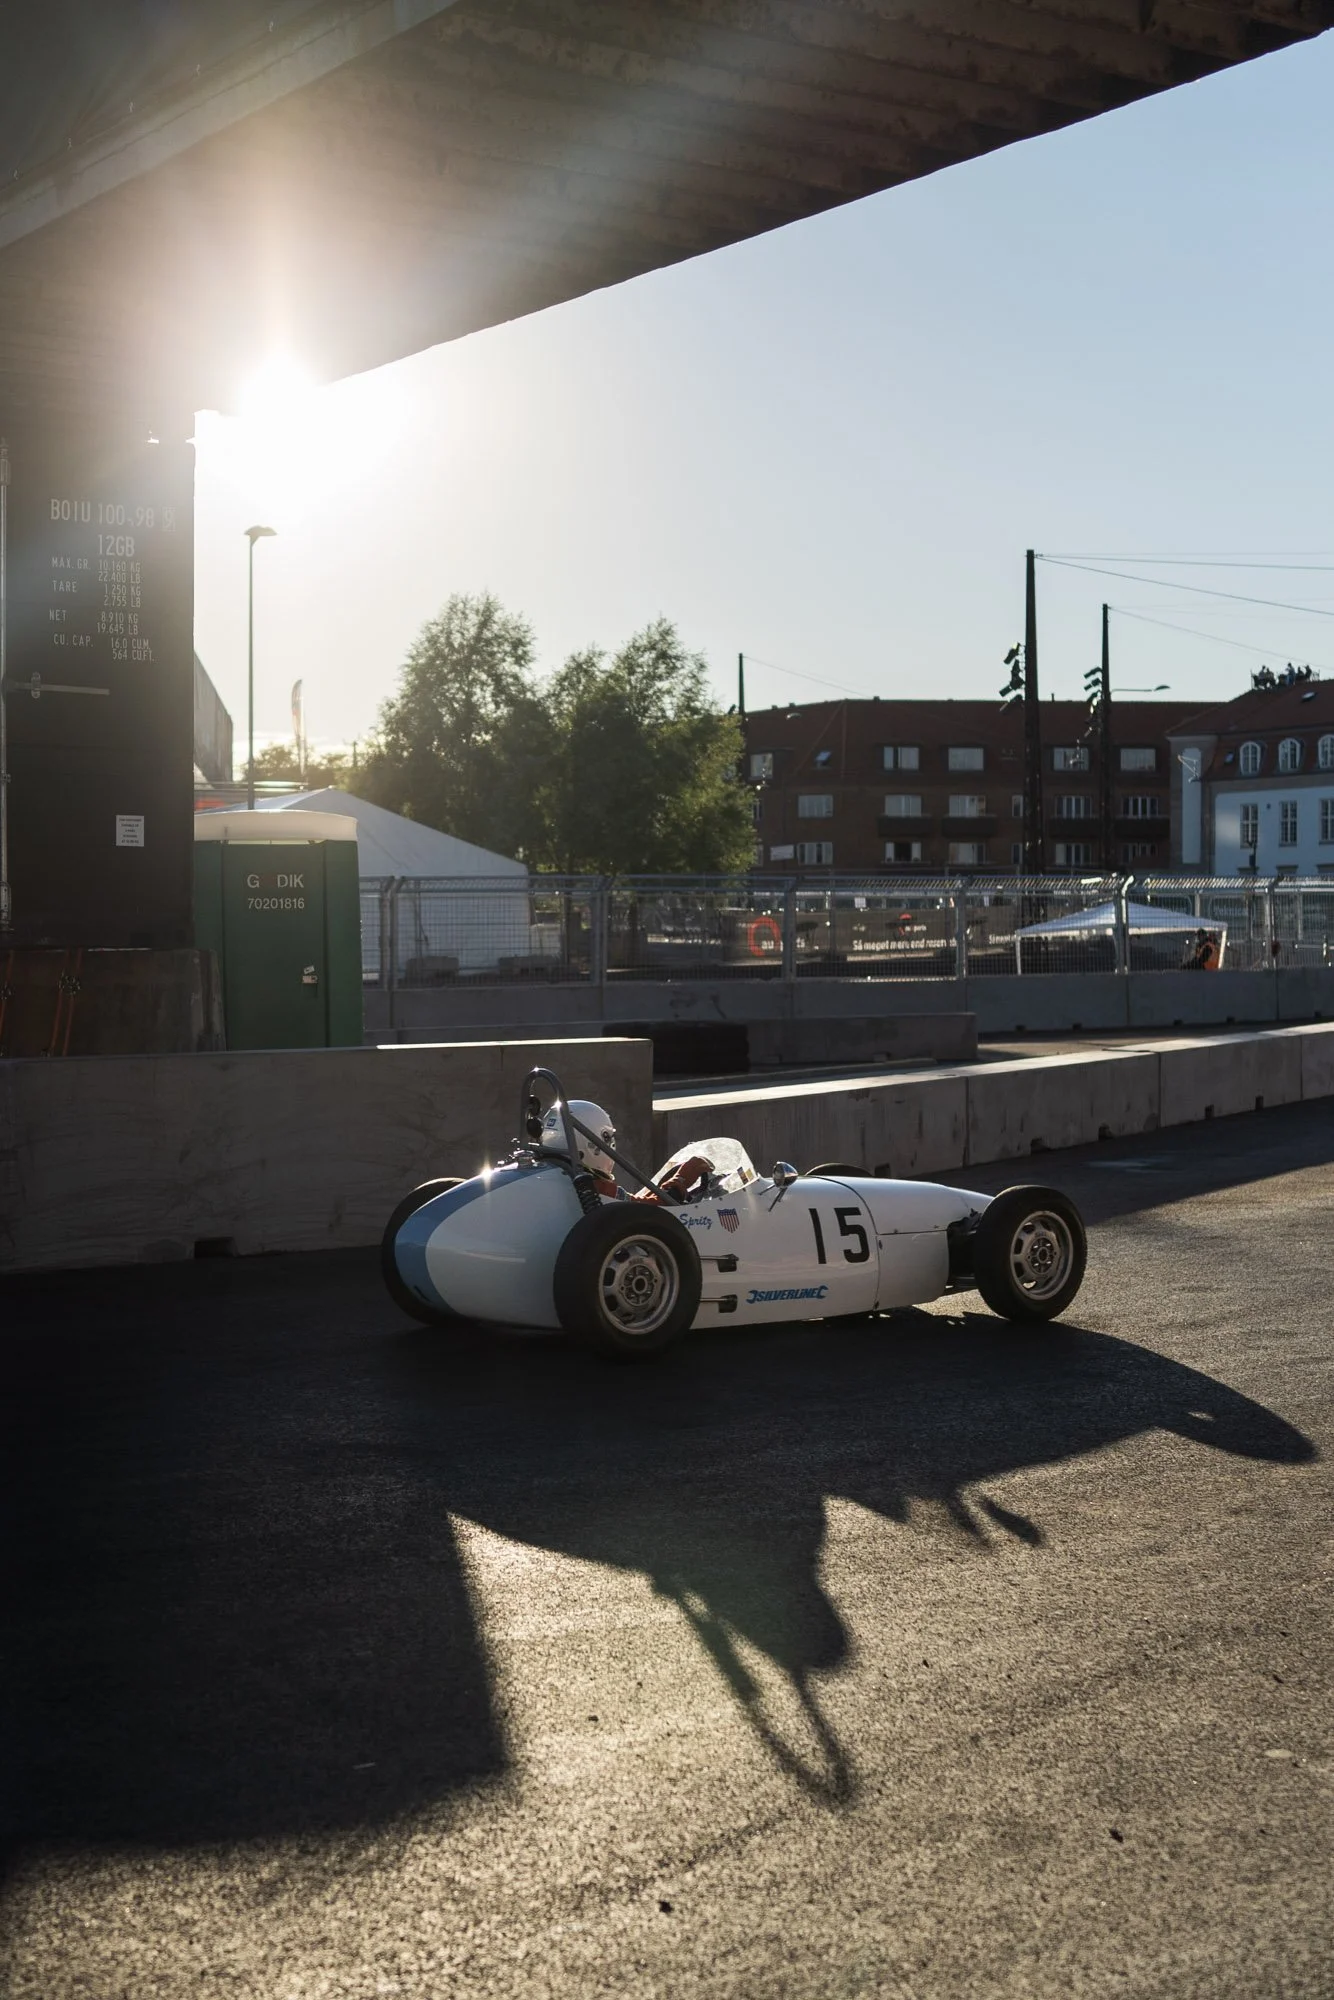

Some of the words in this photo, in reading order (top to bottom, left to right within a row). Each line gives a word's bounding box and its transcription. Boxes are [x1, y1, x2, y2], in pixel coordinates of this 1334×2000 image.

[98, 534, 135, 557] 12GB
[130, 561, 141, 573] KG
[130, 572, 141, 584] LB
[52, 580, 77, 592] TARE
[130, 585, 141, 597] KG
[130, 596, 141, 608] LB
[49, 609, 67, 622] NET
[128, 613, 139, 624] KG
[128, 624, 139, 636] LB
[112, 648, 128, 661] 564
[248, 897, 305, 910] 70201816
[679, 1213, 713, 1230] Spritz
[808, 1206, 870, 1265] 15
